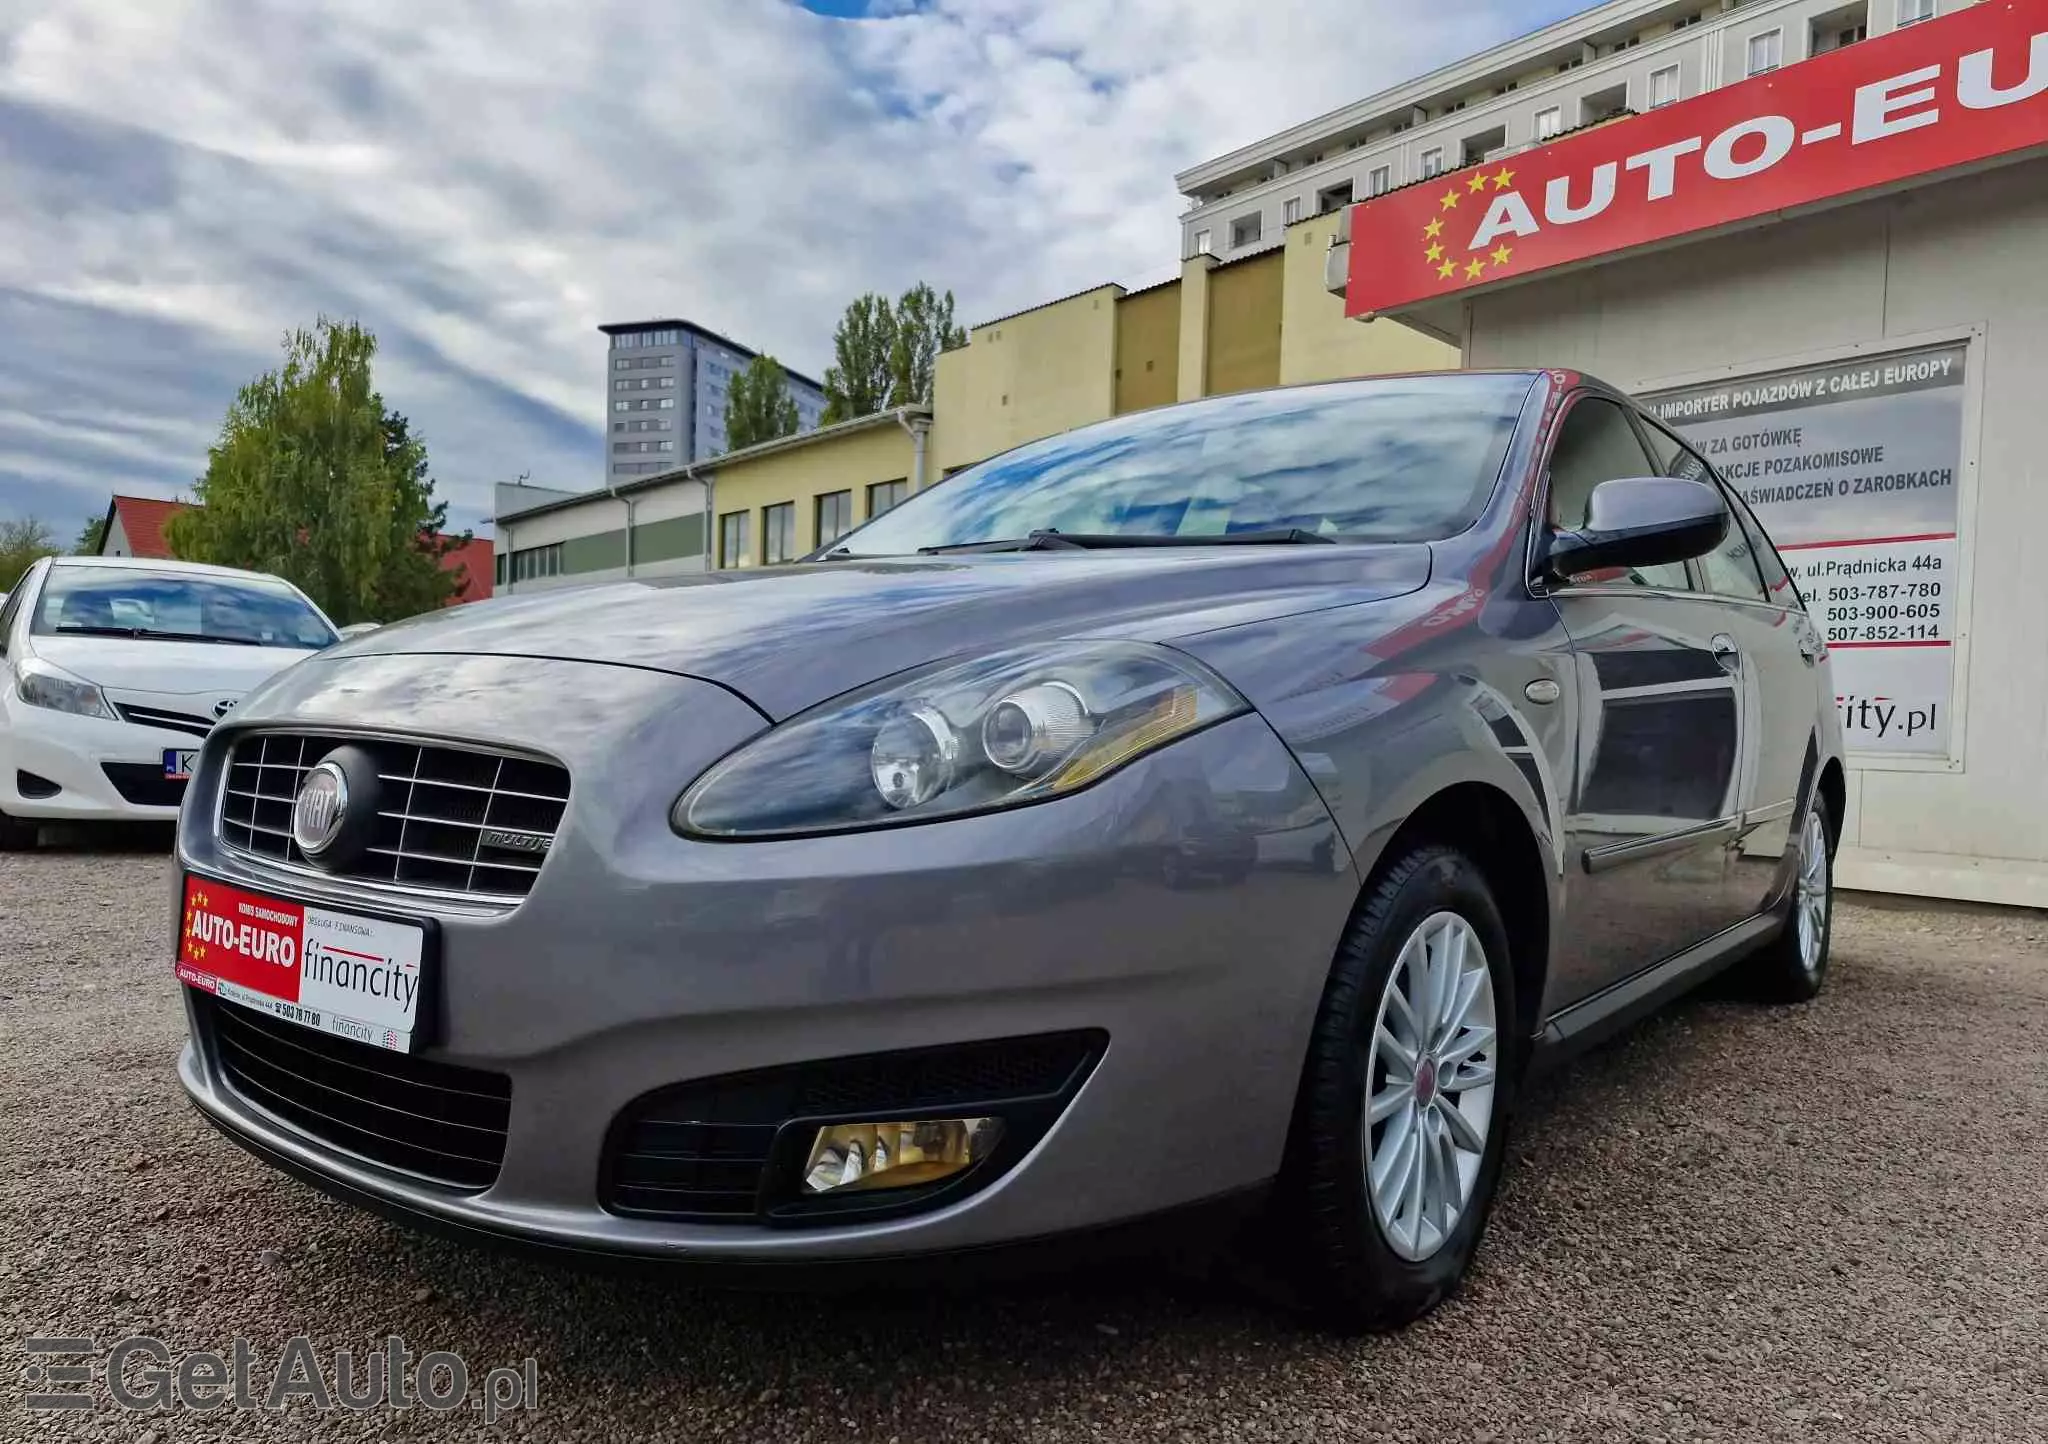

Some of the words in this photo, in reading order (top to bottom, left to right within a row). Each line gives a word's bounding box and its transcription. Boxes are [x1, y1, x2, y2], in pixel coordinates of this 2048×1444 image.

[1660, 393, 1729, 420] IMPORTER
[1733, 379, 1813, 412] POJAZDÓW
[1815, 378, 1826, 396] Z
[1829, 369, 1880, 393] CAŁEJ
[1884, 358, 1952, 385] EUROPY
[1710, 438, 1728, 454] ZA
[1732, 428, 1803, 451] GOTÓWKĘ
[1764, 446, 1884, 475] POZAKOMISOWE
[1738, 477, 1834, 505] AŚWIADCZEŃ
[1838, 479, 1849, 496] O
[1853, 468, 1952, 494] ZAROBKACH
[1912, 554, 1942, 571] 44a
[1801, 588, 1822, 603] el.
[1828, 582, 1942, 602] 503-787-780
[1827, 603, 1941, 622] 503-900-605
[1827, 623, 1939, 641] 507-852-114
[1838, 695, 1937, 738] ity.pl
[181, 754, 194, 773] K
[303, 787, 335, 830] FIAT
[191, 910, 296, 968] AUTO-EURO
[180, 968, 215, 989] AUTO-EURO
[304, 938, 419, 1013] financity
[282, 1003, 295, 1018] 503
[332, 1015, 375, 1042] financity
